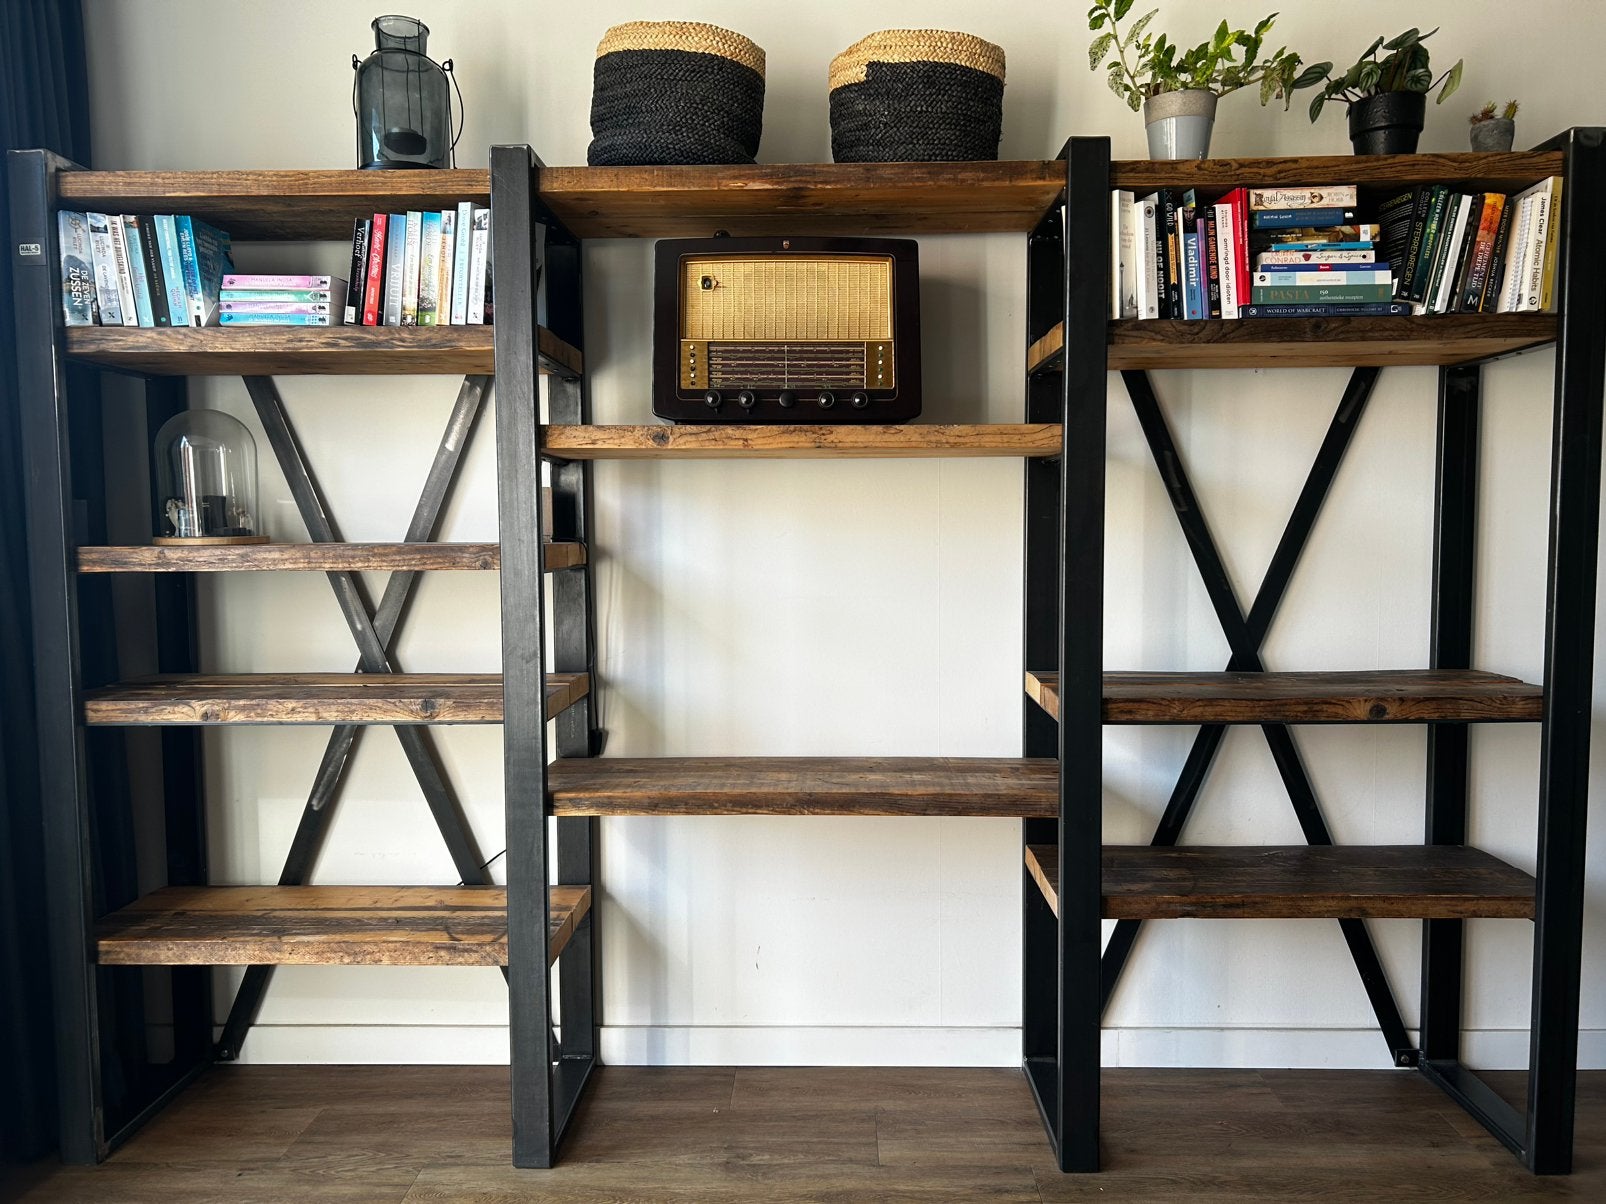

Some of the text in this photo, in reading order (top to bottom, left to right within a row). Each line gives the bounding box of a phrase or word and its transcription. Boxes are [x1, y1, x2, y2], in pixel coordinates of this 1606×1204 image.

[1166, 202, 1174, 211] GO
[1422, 192, 1430, 217] COLLEEN
[1435, 191, 1444, 212] COLLEEN
[1166, 212, 1174, 226] WILD
[355, 227, 365, 258] Verhoef
[1156, 240, 1162, 254] NU
[1404, 222, 1423, 286] STERRENREGEN
[1534, 239, 1543, 266] Atomic
[1157, 256, 1163, 268] OF
[1188, 238, 1198, 286] Vladimir
[1471, 242, 1486, 288] DE DIEPE TIJD
[1479, 242, 1492, 277] GEHEIMEN
[69, 267, 82, 306] ZUSSEN
[81, 270, 90, 304] DE ZEVEN
[390, 263, 401, 308] VRIJUIT
[1530, 268, 1540, 292] Habits
[1270, 290, 1310, 300] PASTA
